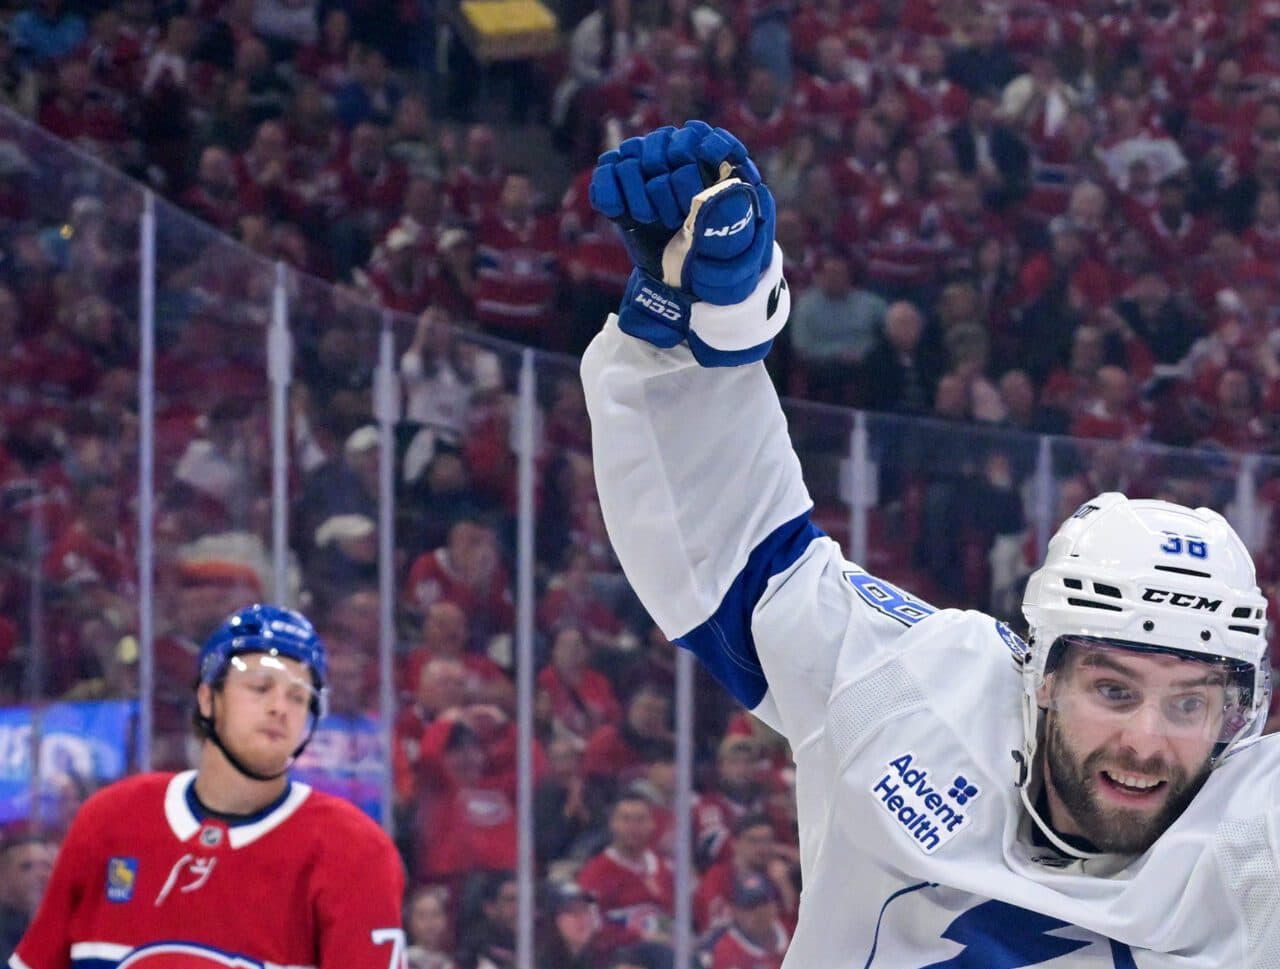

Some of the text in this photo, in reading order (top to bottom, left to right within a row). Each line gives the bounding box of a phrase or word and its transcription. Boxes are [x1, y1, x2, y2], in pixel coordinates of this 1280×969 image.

[635, 294, 682, 321] CCM
[1161, 530, 1208, 559] 38
[1141, 588, 1222, 612] CCM
[889, 754, 964, 832] Advent
[873, 774, 940, 850] Health
